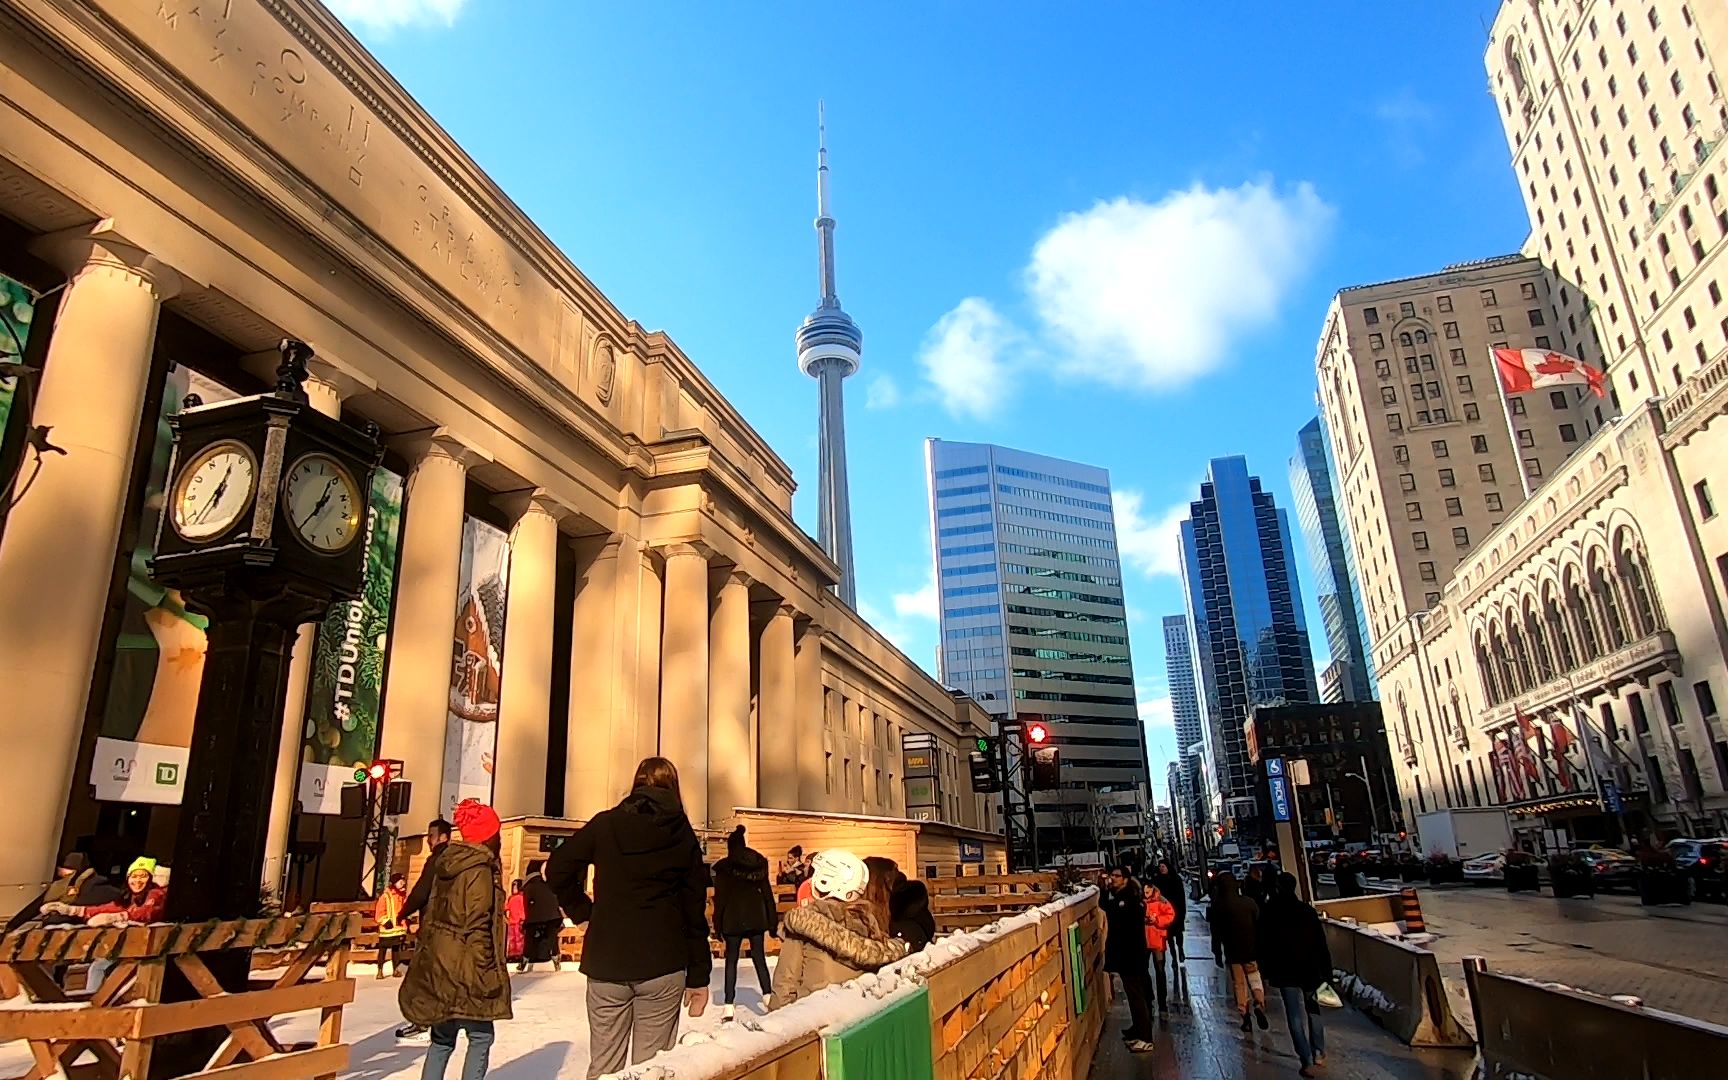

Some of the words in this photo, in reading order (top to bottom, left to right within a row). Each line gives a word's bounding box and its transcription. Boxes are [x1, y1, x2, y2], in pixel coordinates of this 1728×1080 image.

[417, 184, 521, 287] GRAD
[158, 766, 177, 782] TD
[1273, 780, 1284, 801] PICK
[1277, 803, 1286, 816] UP
